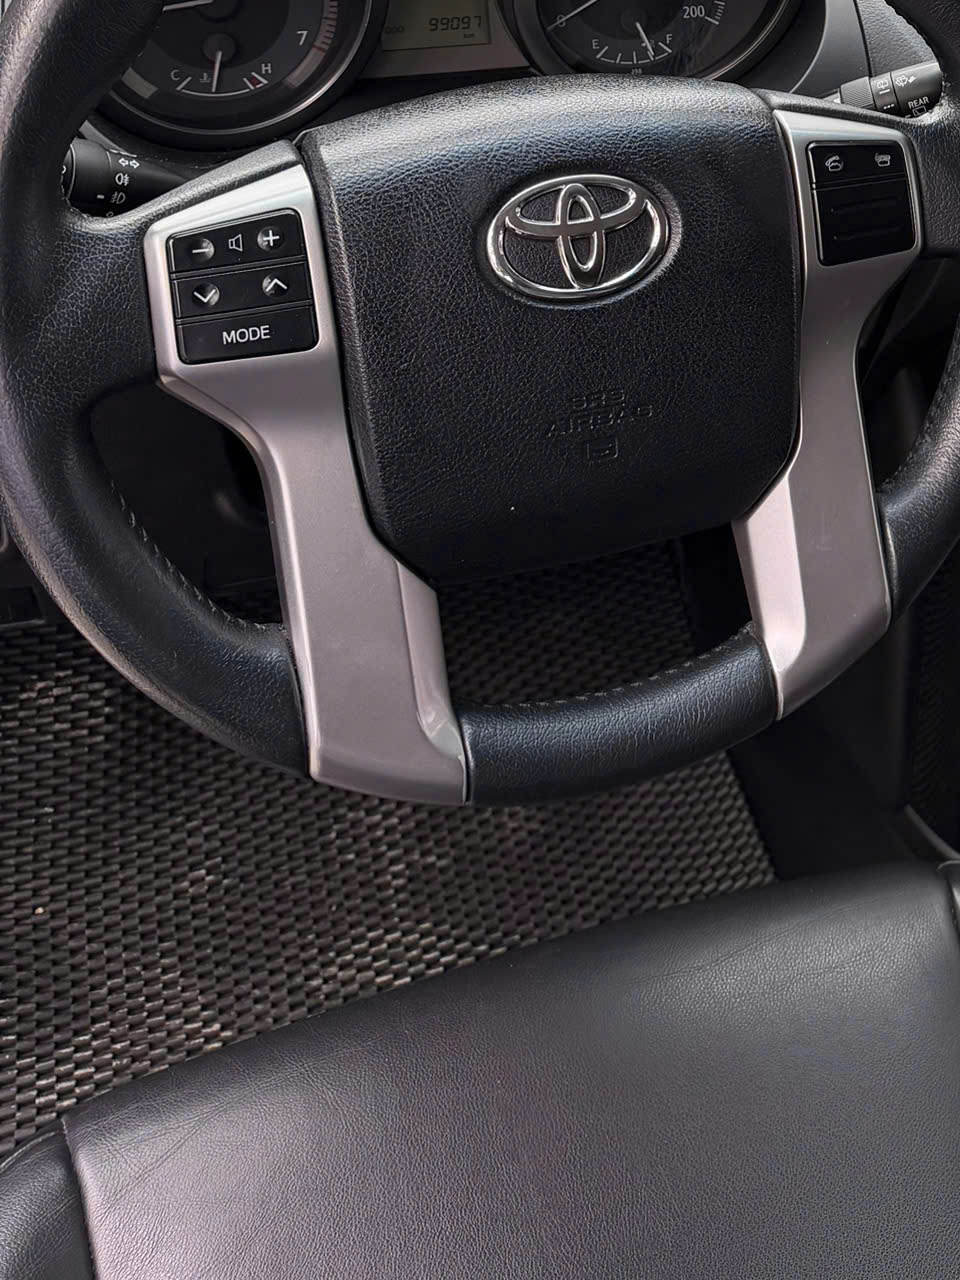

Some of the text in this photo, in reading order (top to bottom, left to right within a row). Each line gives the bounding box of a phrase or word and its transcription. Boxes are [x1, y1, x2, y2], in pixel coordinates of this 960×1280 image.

[683, 6, 705, 19] 200
[429, 15, 482, 32] 99097
[297, 30, 308, 46] 7
[592, 39, 600, 50] E
[666, 34, 673, 45] F
[171, 70, 180, 80] C
[261, 63, 272, 74] H
[908, 96, 930, 109] REAR
[222, 324, 271, 345] MODE
